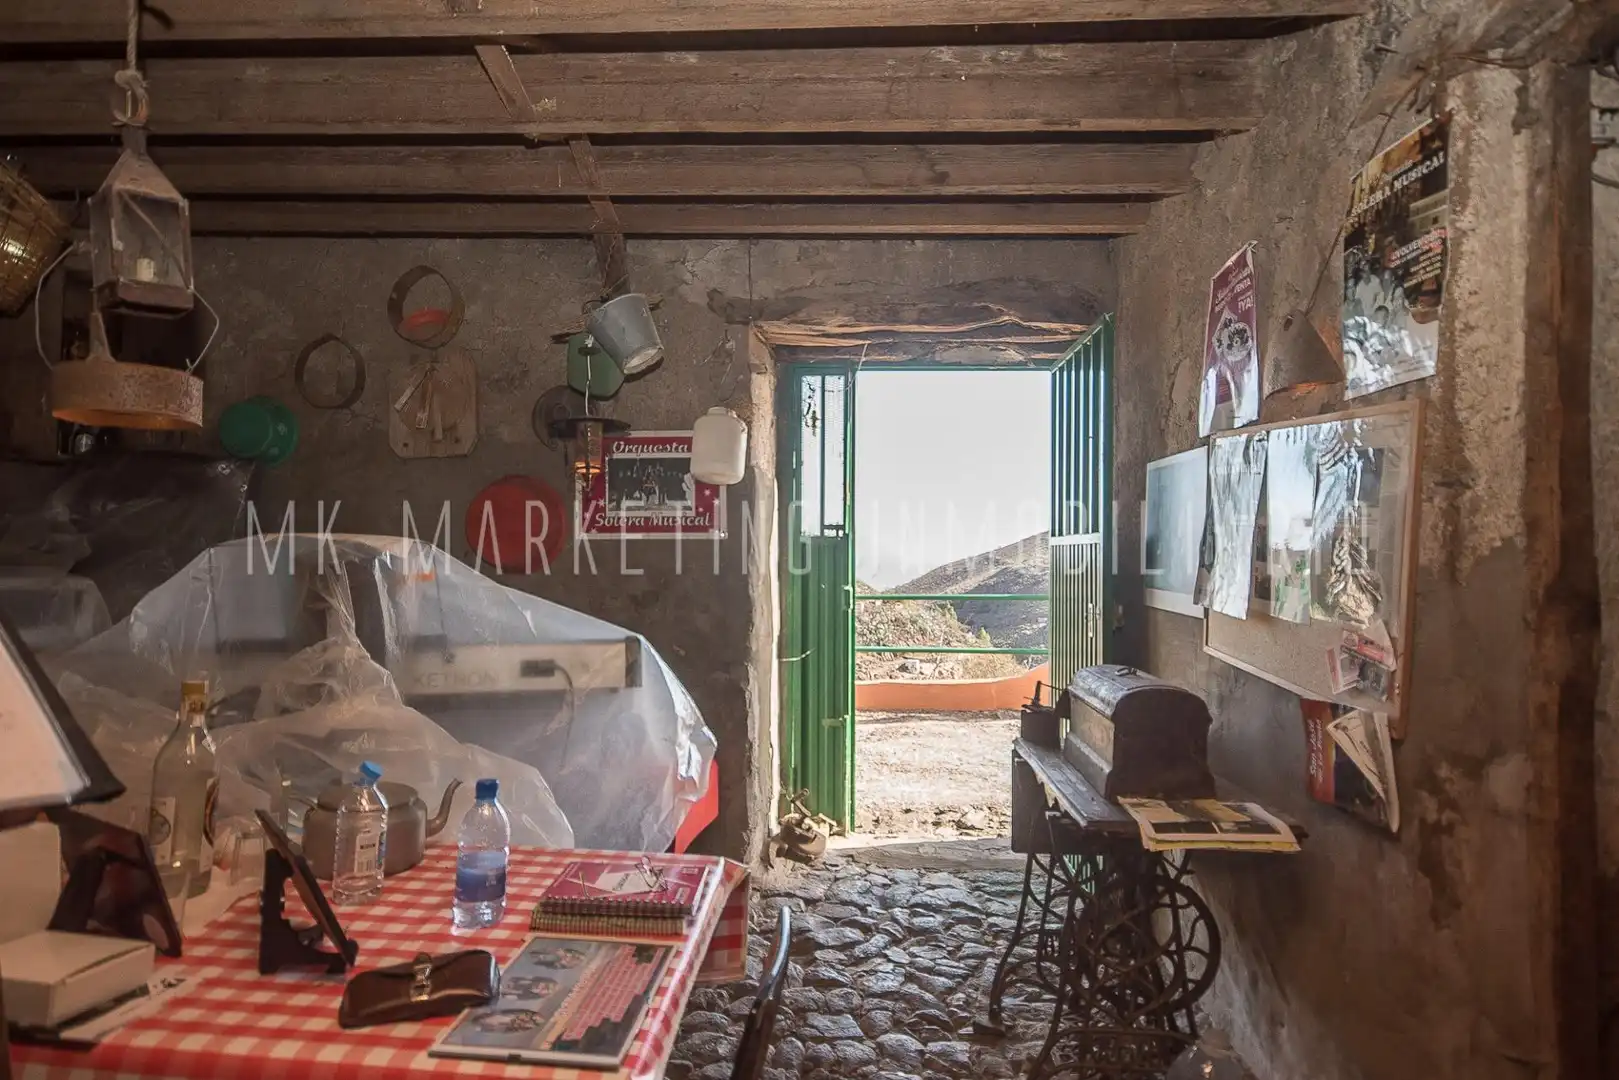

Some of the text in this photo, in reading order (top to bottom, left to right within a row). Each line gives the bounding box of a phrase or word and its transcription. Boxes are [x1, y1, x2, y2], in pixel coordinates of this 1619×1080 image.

[612, 440, 688, 456] Orquesta
[594, 512, 711, 526] Solera Musical
